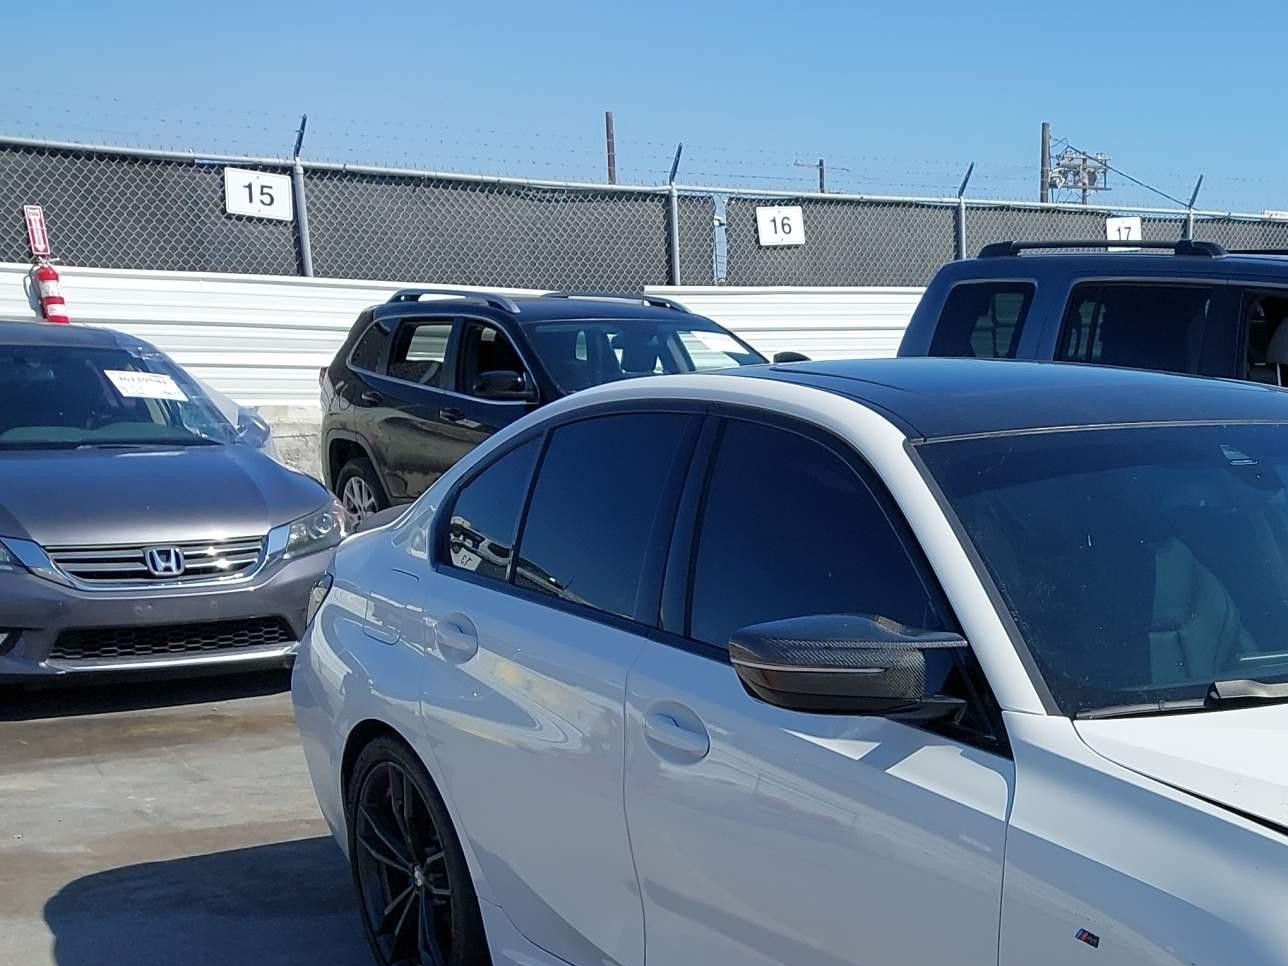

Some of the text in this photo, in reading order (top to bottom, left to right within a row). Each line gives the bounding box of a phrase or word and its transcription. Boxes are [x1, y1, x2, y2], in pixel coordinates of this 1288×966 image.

[243, 182, 275, 207] 15
[769, 216, 792, 235] 16
[1116, 226, 1132, 241] 17
